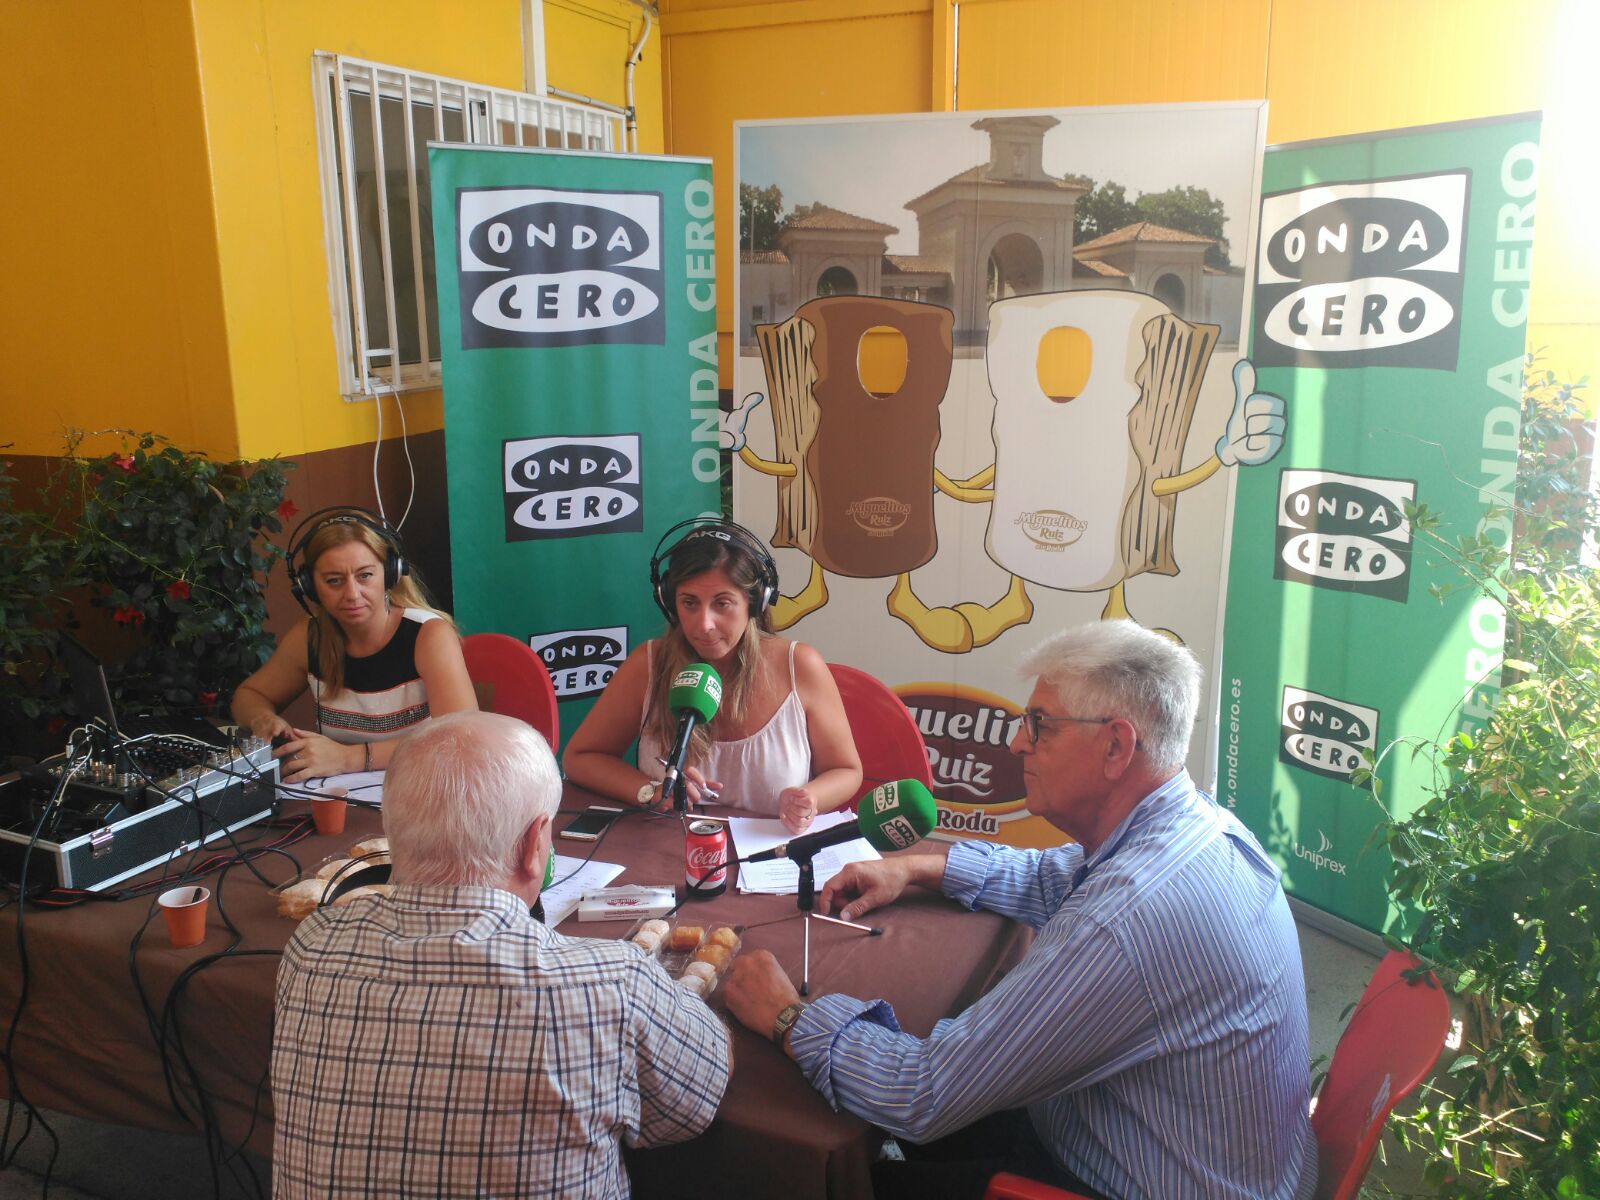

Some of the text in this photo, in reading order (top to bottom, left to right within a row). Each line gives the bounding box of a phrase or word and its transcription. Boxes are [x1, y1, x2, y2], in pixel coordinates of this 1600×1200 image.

[487, 222, 632, 253] ONDA
[684, 178, 716, 313] CERO
[1283, 219, 1428, 262] ONDA
[1491, 141, 1539, 328] CERO
[498, 283, 635, 319] CERO
[1288, 294, 1426, 336] CERO
[689, 331, 720, 483] ONDA
[524, 457, 621, 480] ONDA
[531, 495, 623, 521] CERO
[870, 514, 892, 527] Ruiz
[1014, 512, 1088, 532] Miguelitos
[1295, 493, 1389, 526] ONDA
[1040, 527, 1064, 541] Ruiz
[1297, 539, 1387, 575] CERO
[543, 642, 614, 662] ONDA
[1461, 598, 1507, 736] ERO
[905, 706, 1024, 746] uelit
[1293, 705, 1361, 737] ONDA
[1227, 678, 1241, 809] w.ondacero.es
[1295, 737, 1360, 769] CERO
[937, 809, 998, 833] Roda
[1294, 842, 1346, 876] Uniprex
